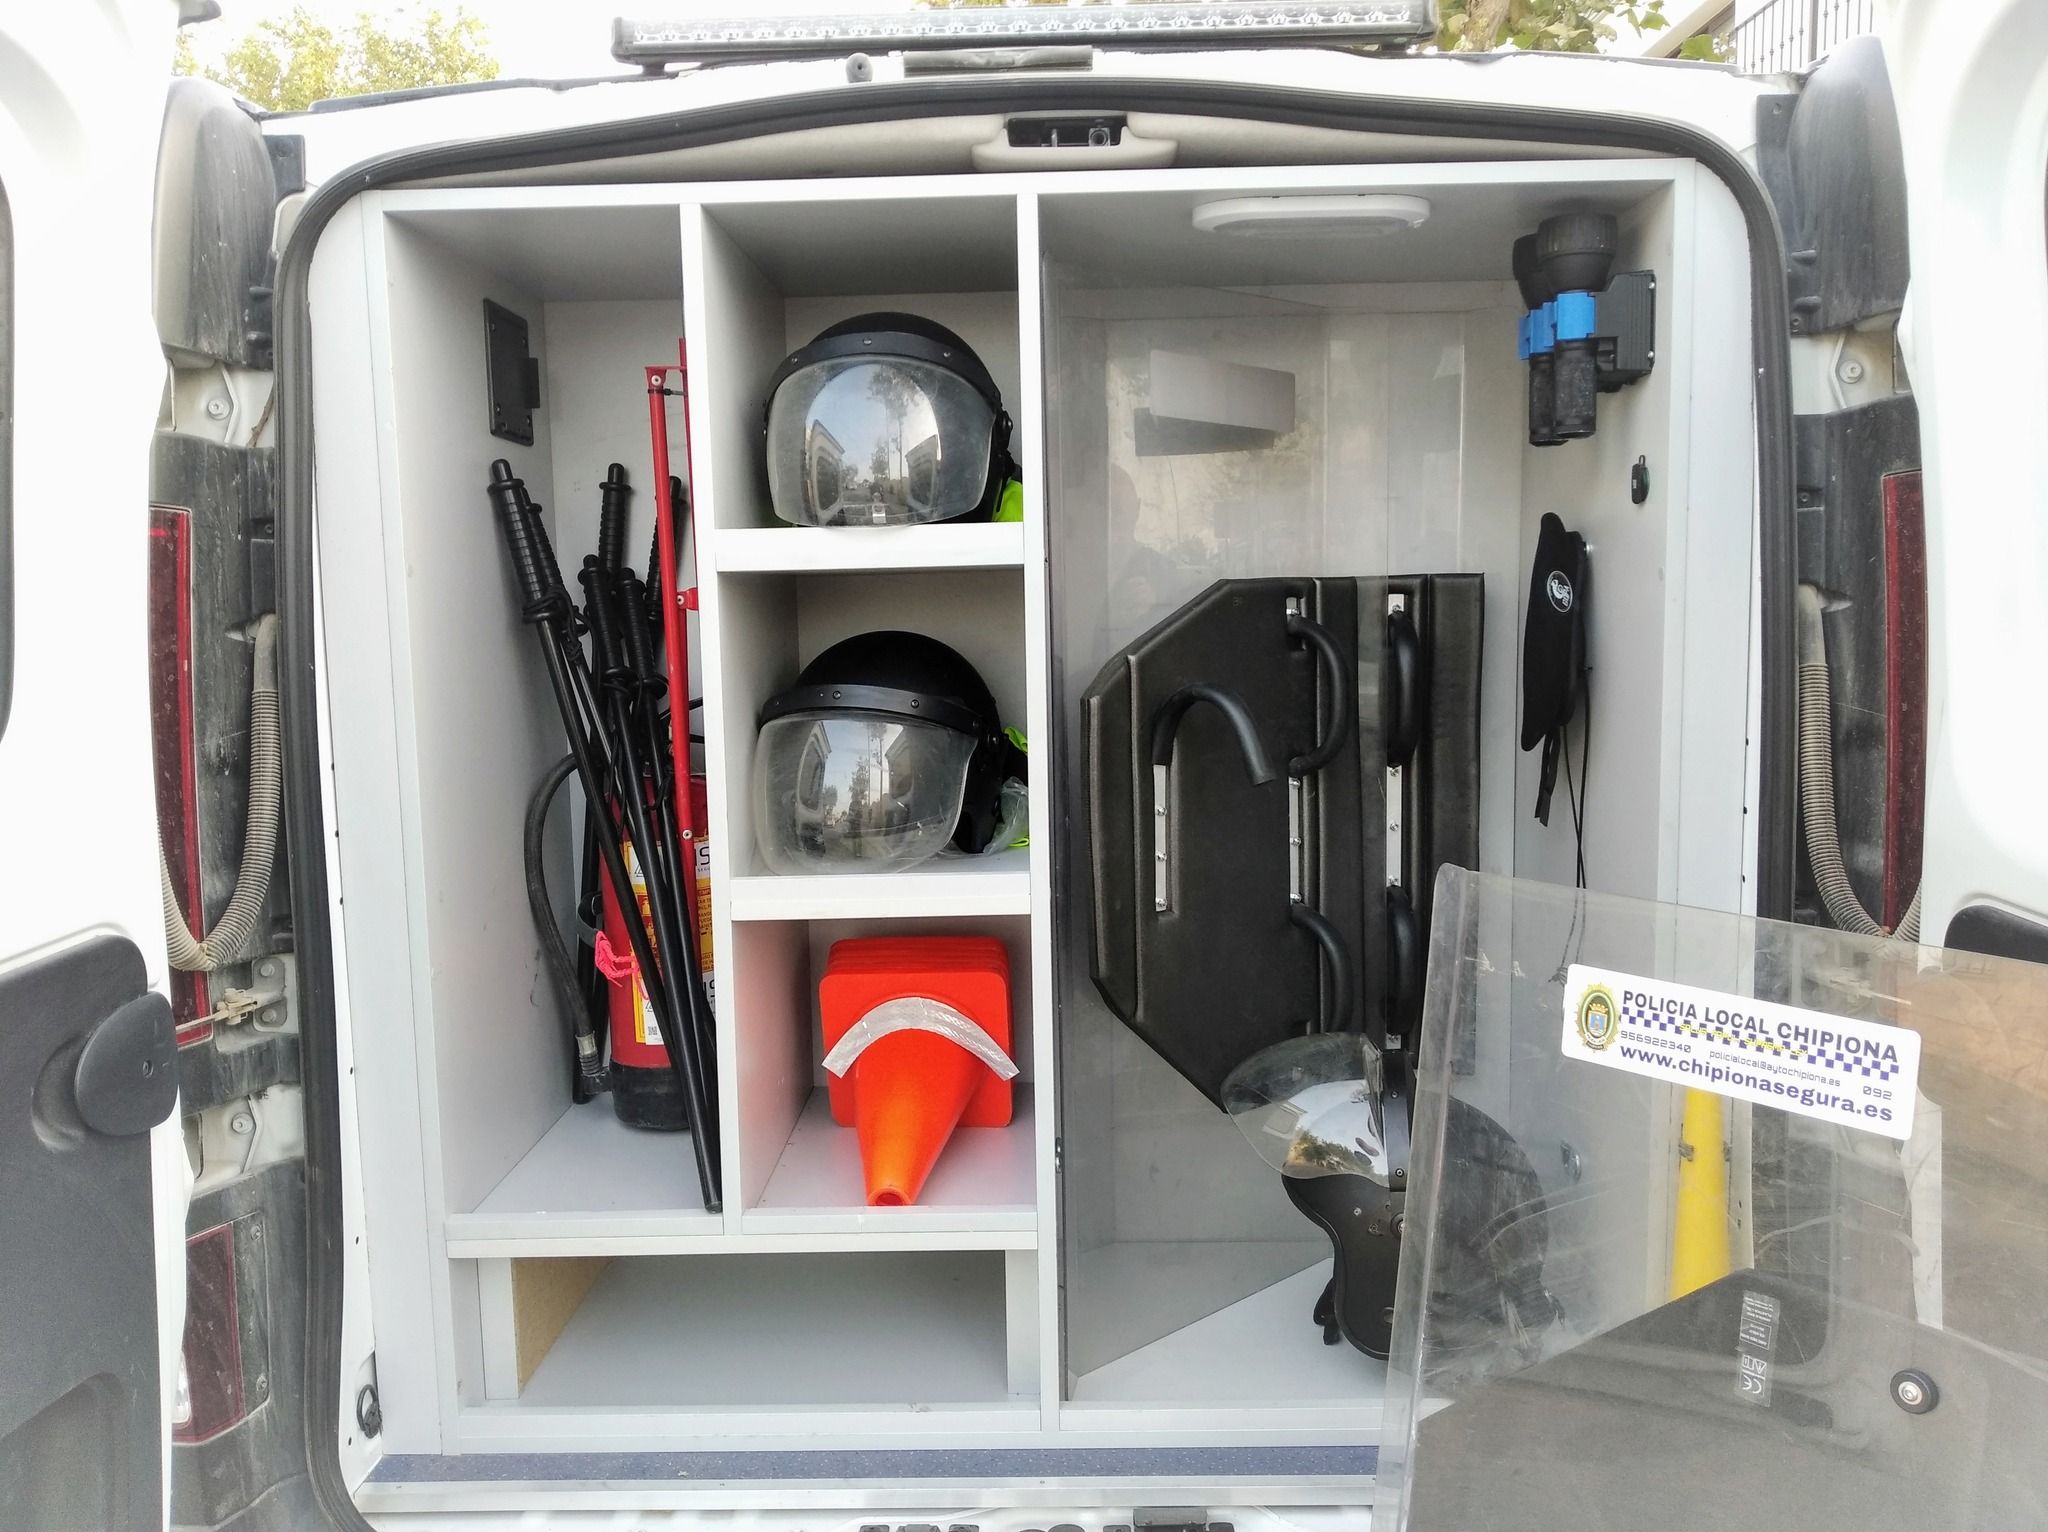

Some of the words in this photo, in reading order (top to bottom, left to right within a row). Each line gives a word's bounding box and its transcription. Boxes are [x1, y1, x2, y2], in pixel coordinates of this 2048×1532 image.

[1623, 990, 1698, 1020] POLICIA
[1704, 1006, 1770, 1035] LOCAL
[1777, 1022, 1898, 1063] CHIPIONA
[1620, 1030, 1692, 1054] 956922340
[1709, 1050, 1841, 1087] policialocal@aytochipiona.es
[1862, 1085, 1893, 1101] 092
[1620, 1045, 1893, 1122] www.chipionasegura.es
